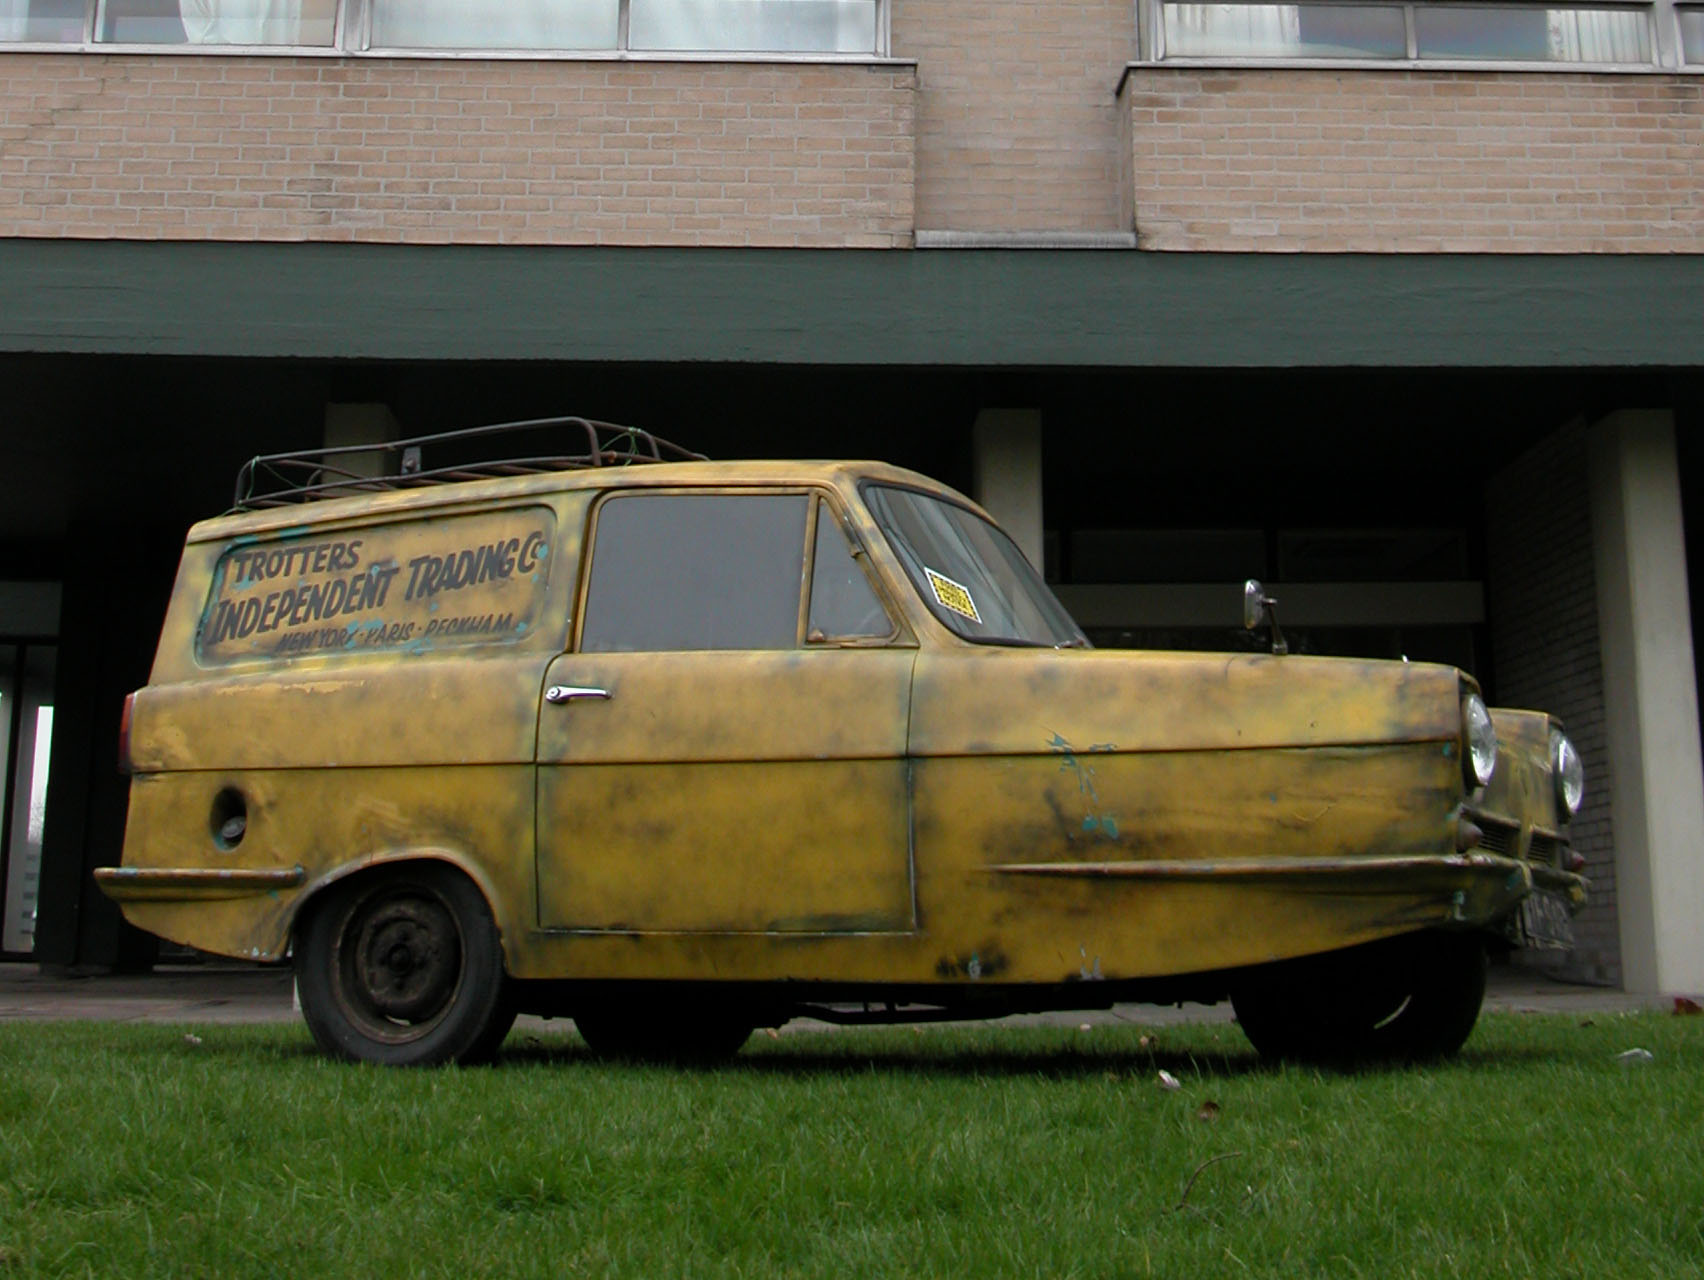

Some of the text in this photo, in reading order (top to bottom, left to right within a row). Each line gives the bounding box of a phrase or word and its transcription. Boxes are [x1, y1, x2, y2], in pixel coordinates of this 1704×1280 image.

[233, 539, 364, 584] TROTTERS
[206, 566, 400, 646] INDEPENDENT
[404, 537, 520, 601] TRADING
[277, 628, 319, 652] NEW
